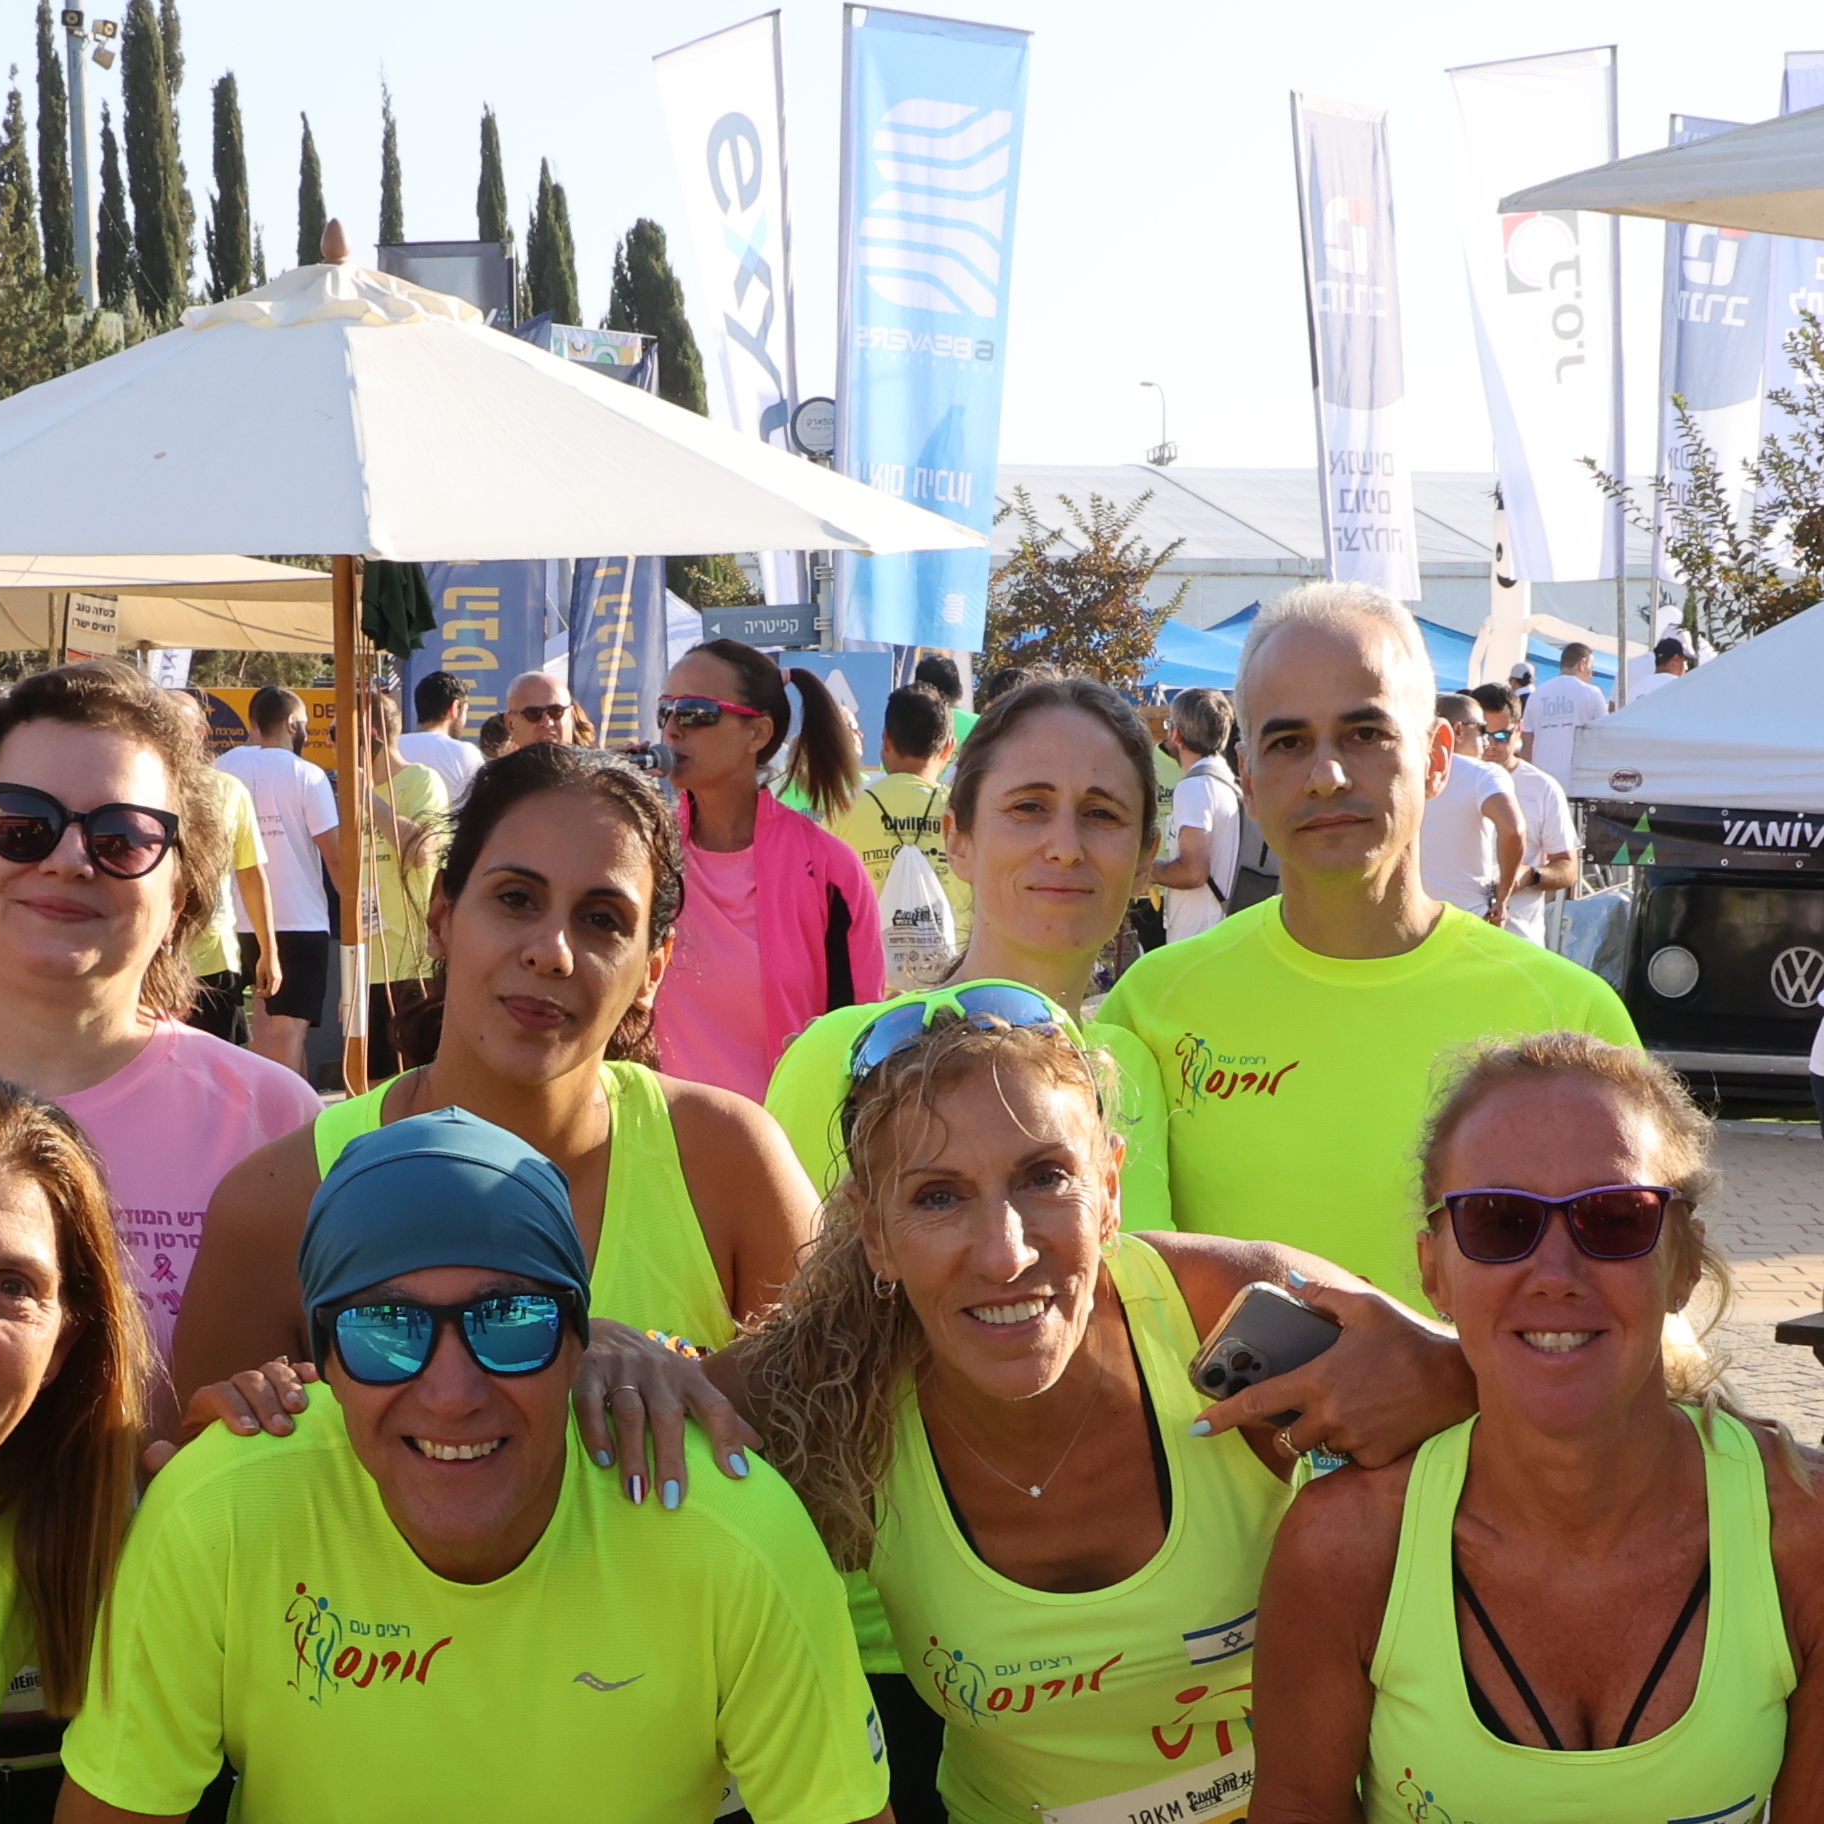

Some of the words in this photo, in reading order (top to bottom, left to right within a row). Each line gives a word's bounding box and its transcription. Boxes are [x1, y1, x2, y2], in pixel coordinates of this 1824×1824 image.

[744, 616, 800, 636] קפיטריה
[1239, 1055, 1267, 1067] רצים
[177, 1211, 206, 1228] דש
[154, 1231, 201, 1250] סרטן
[349, 1619, 372, 1638] עם
[376, 1621, 411, 1639] רצים
[334, 1636, 453, 1689] לורנס
[994, 1659, 1022, 1677] עם
[1030, 1653, 1074, 1673] רצים
[986, 1652, 1125, 1714] לורנס
